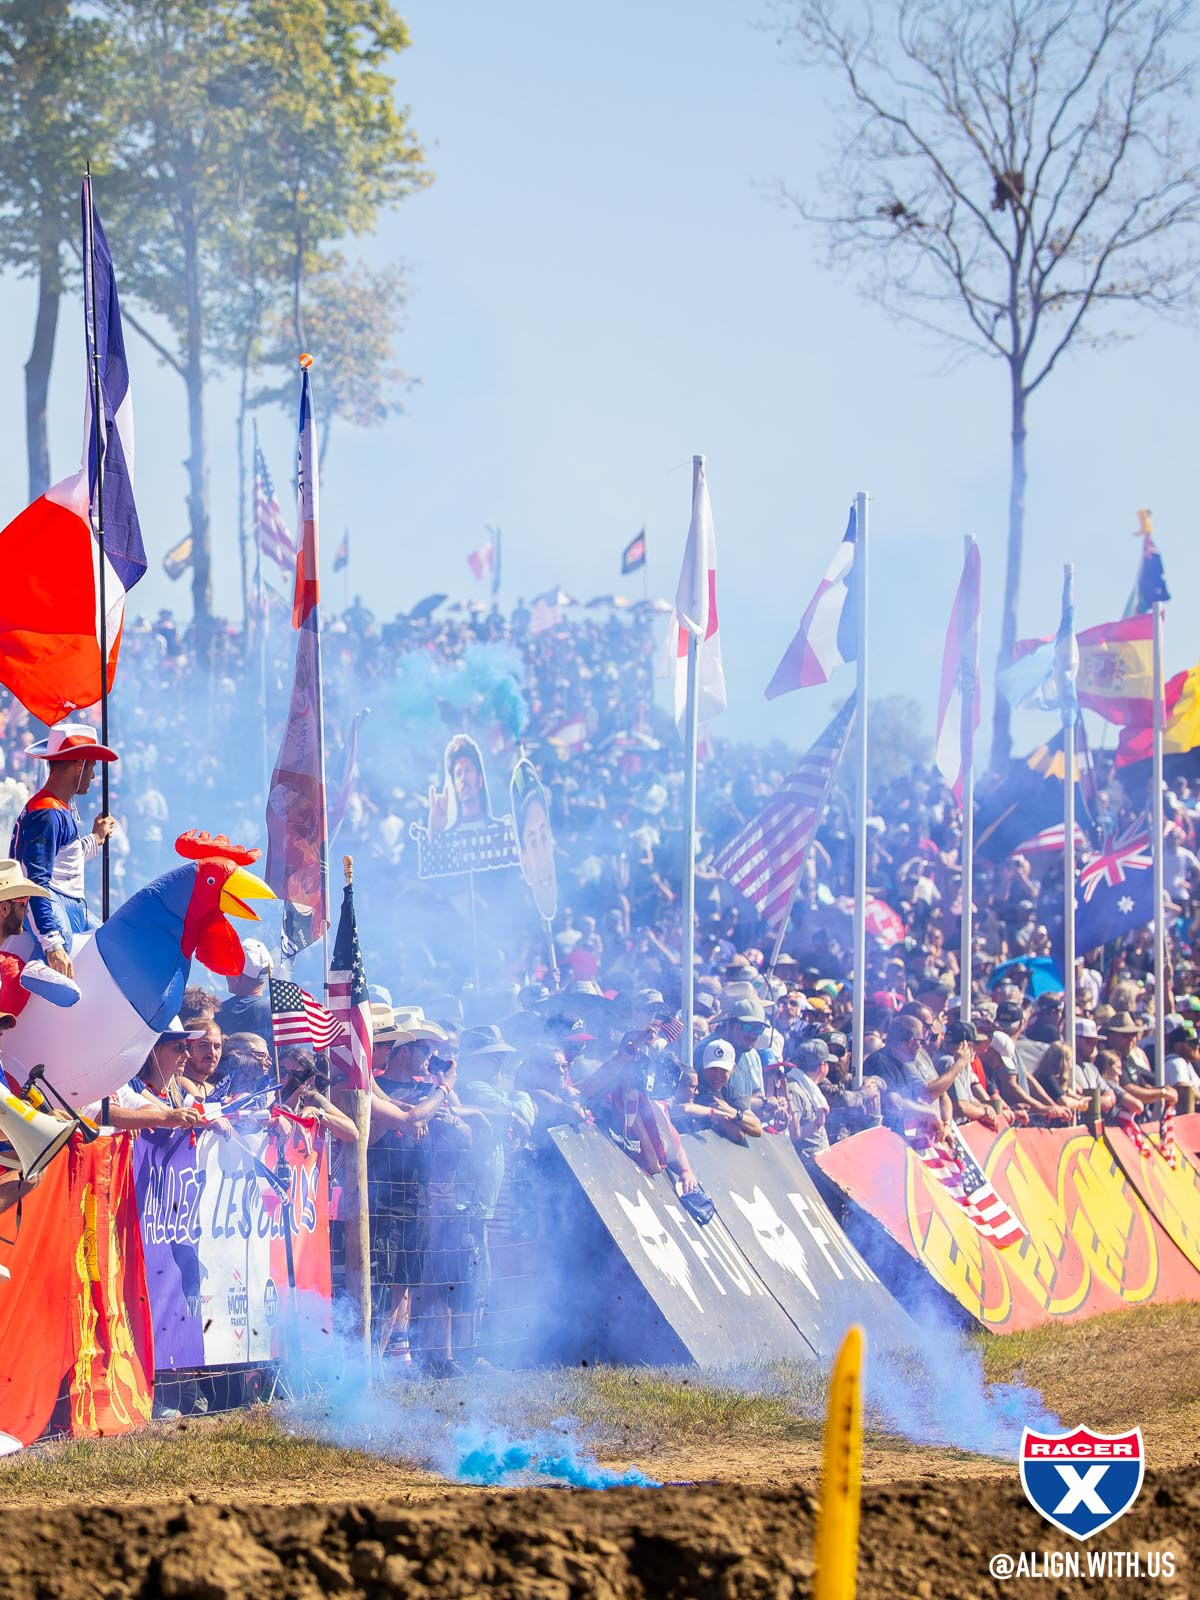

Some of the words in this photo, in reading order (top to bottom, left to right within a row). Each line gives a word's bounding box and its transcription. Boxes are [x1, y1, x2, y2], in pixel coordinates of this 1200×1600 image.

[143, 1165, 207, 1245] ALLEZ
[211, 1168, 257, 1240] LES
[227, 1294, 248, 1315] MOTO
[230, 1316, 247, 1328] FRANCE
